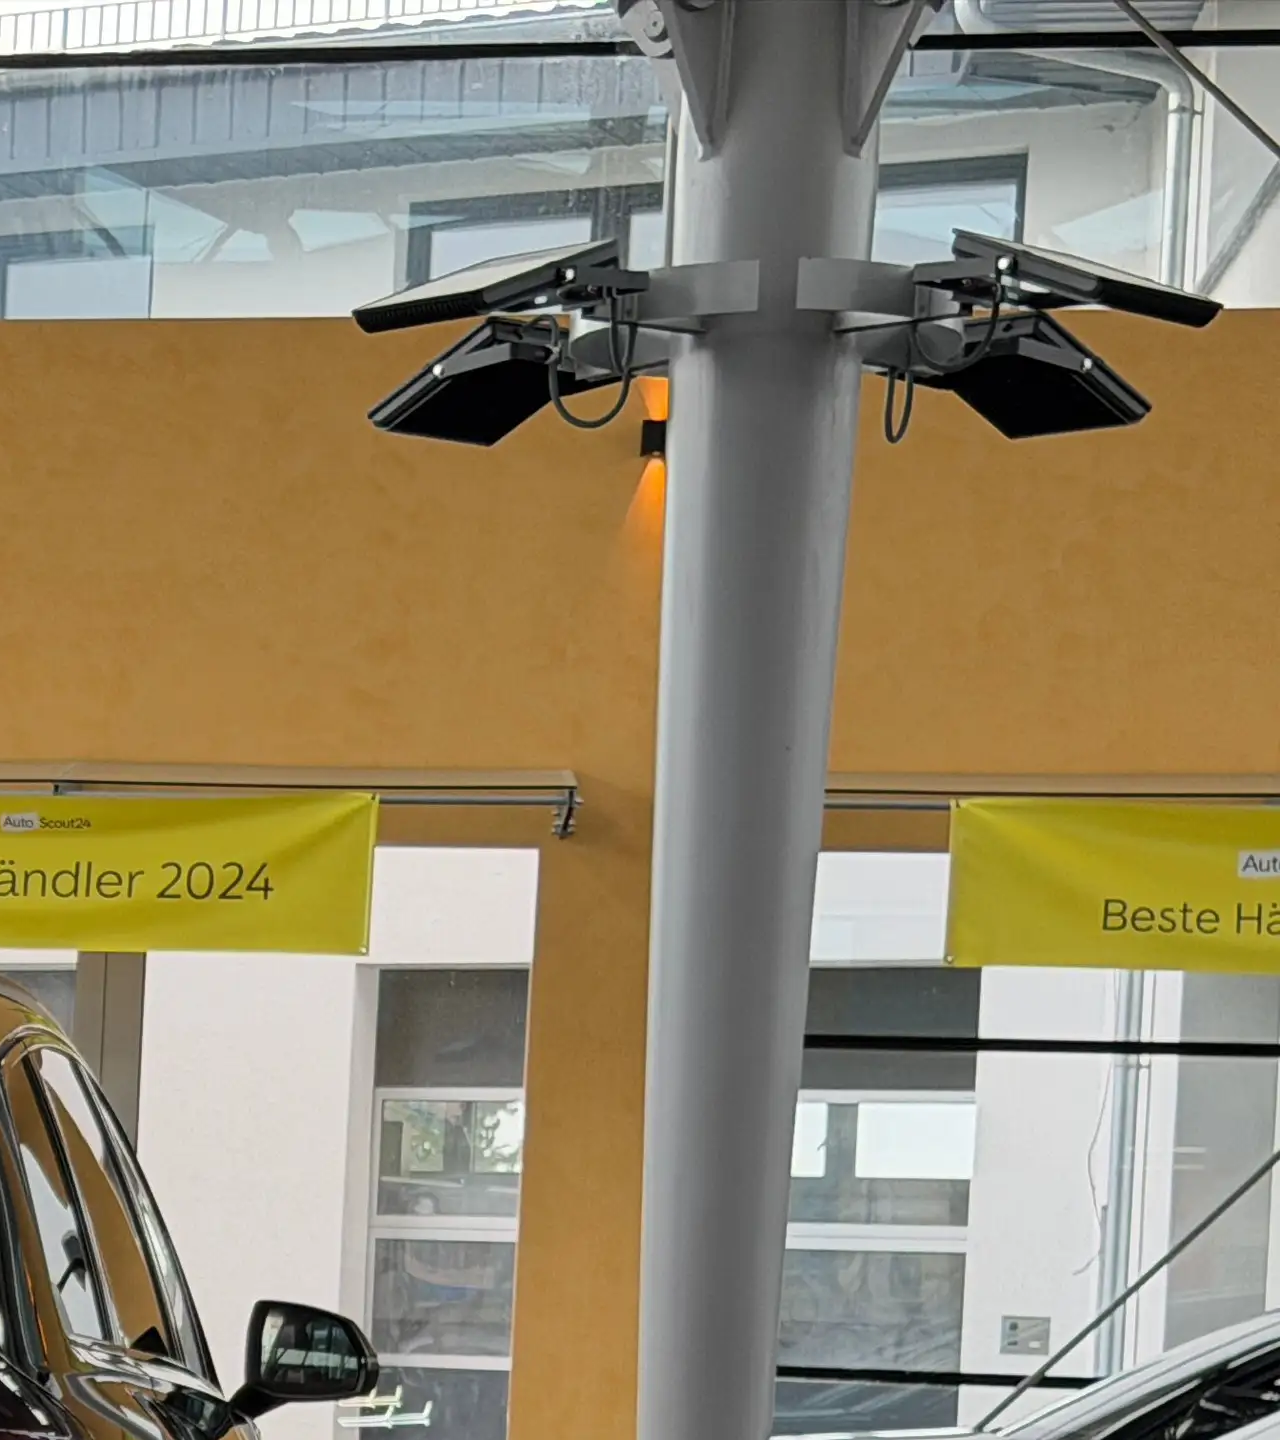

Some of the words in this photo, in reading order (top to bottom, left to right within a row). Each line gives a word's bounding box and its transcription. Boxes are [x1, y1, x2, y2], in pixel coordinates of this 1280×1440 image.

[156, 861, 275, 901] 2024
[1241, 854, 1280, 873] Aut
[1102, 898, 1220, 935] Beste
